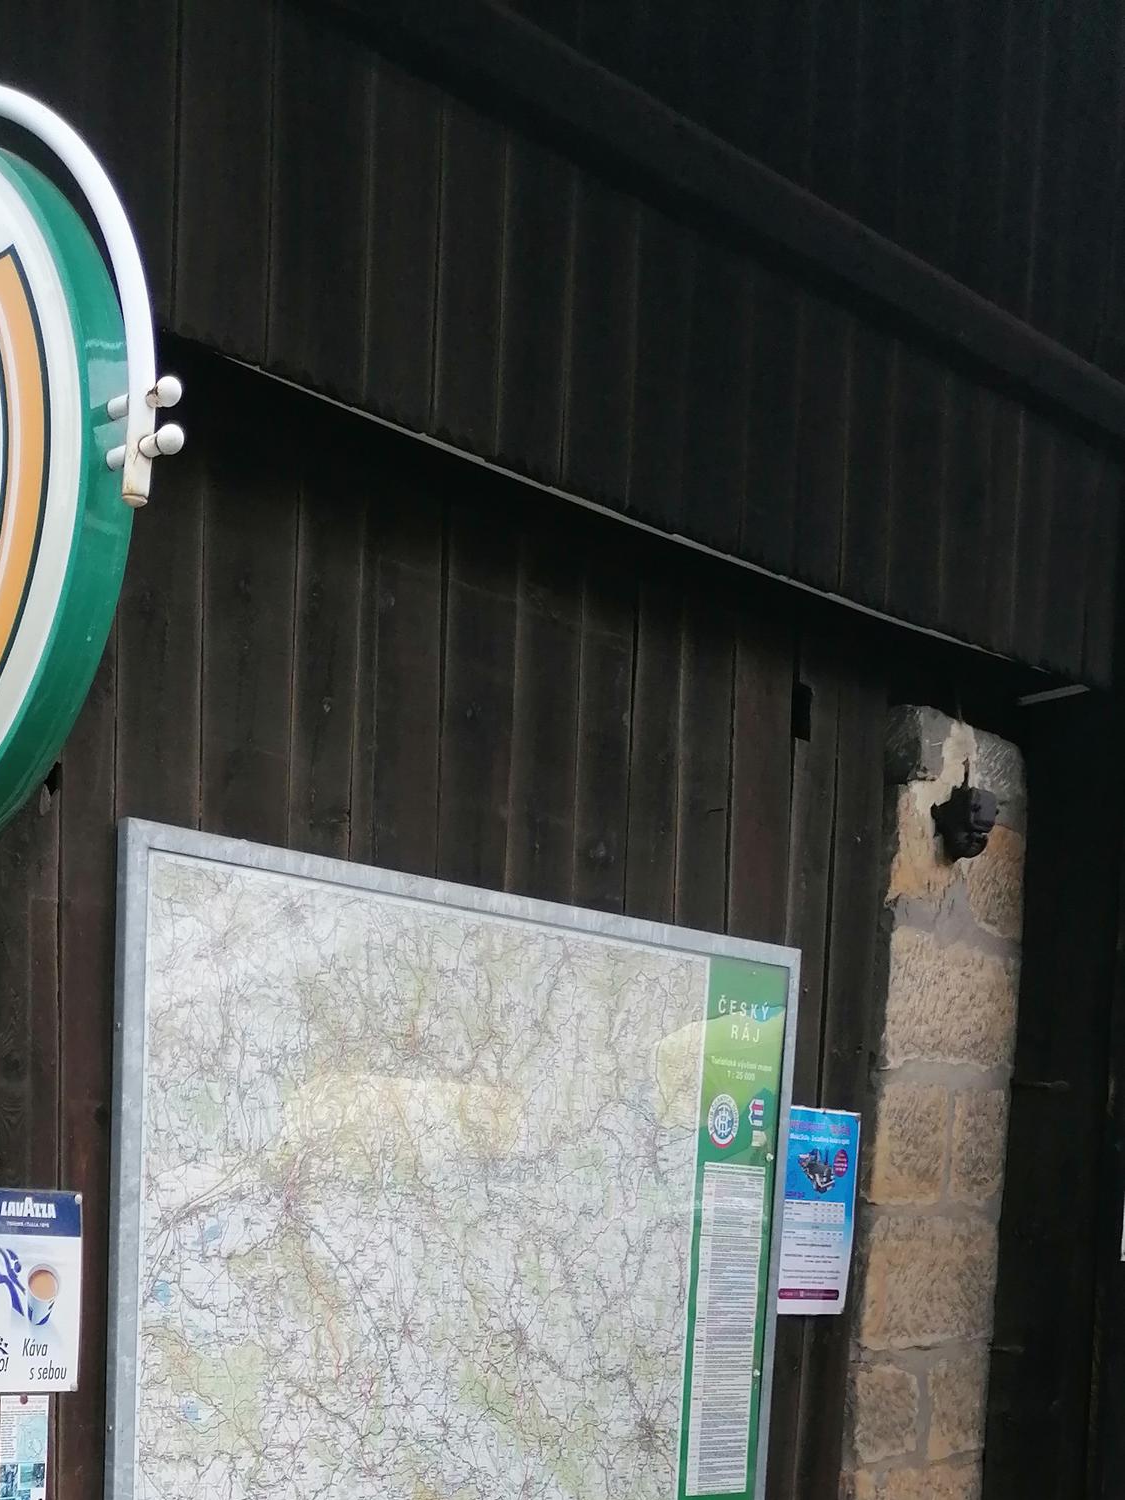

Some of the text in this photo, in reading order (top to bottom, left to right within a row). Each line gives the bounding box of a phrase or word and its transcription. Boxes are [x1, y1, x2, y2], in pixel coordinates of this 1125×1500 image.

[717, 995, 771, 1021] ČESKÝ
[730, 1022, 761, 1043] RÁJ
[0, 1196, 57, 1219] LAVAZZA
[22, 1338, 48, 1357] Káva
[29, 1360, 67, 1380] s sebou
